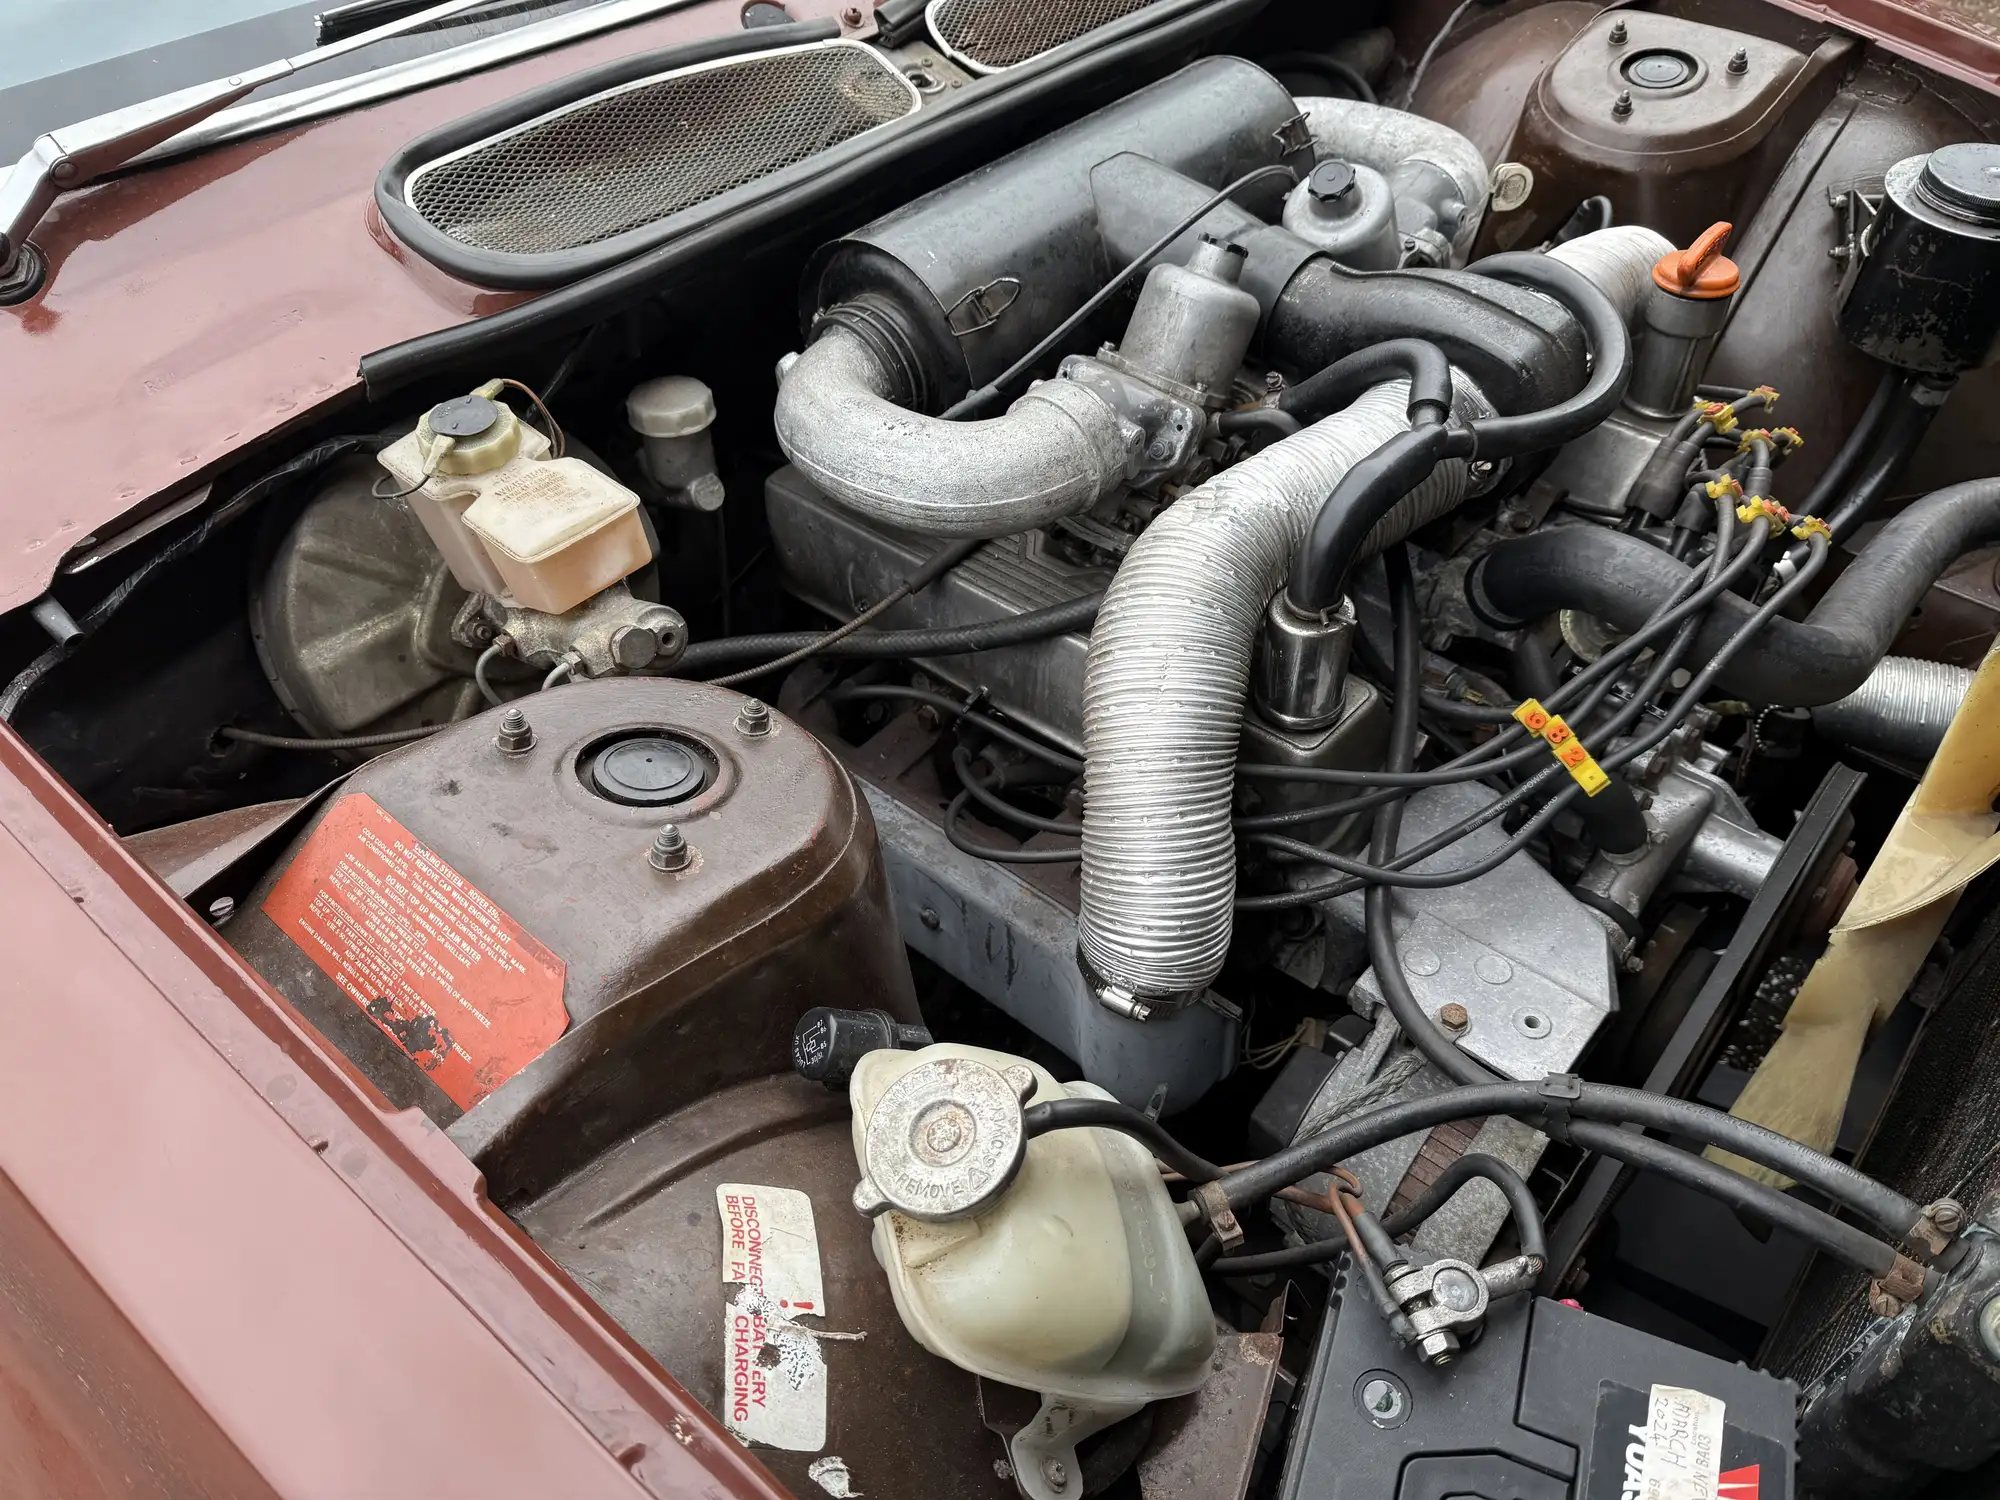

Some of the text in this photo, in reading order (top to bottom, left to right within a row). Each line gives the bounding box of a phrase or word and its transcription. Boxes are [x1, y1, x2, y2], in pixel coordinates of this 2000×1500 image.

[1548, 723, 1569, 744] 8
[1561, 746, 1585, 767] 2
[1521, 767, 1550, 793] POWER
[1539, 795, 1558, 814] LEAD
[347, 869, 376, 896] PROTECTION
[373, 893, 390, 909] DOWN
[354, 860, 382, 887] ANTI-FREEZE
[384, 888, 407, 909] BLUECOL
[411, 912, 438, 938] UNIVERSAL
[361, 827, 376, 841] COLD
[373, 838, 396, 859] COOLANT
[394, 856, 410, 871] LEVEL
[412, 871, 424, 883] FILL
[422, 880, 450, 906] EXPANSION
[447, 903, 462, 917] TANK
[364, 841, 395, 869] CONDITIONED
[393, 866, 408, 880] CARS
[410, 880, 424, 895] TURN
[422, 892, 457, 923] TEMPERATURE
[454, 920, 479, 943] CONTROL
[484, 946, 500, 961] FULL
[414, 858, 440, 882] REMOVE
[450, 890, 470, 909] WHEN
[467, 905, 491, 927] ENGINE
[439, 865, 464, 888] SYSTEM
[467, 889, 490, 910] ROVER
[308, 903, 325, 920] REFILL
[343, 938, 361, 955] LITRES
[378, 971, 394, 987] PINTS
[327, 898, 356, 926] PROTECTION
[352, 922, 369, 939] DOWN
[328, 874, 345, 890] REFILL
[364, 908, 382, 925] LITRES
[398, 939, 414, 956] PINTS
[426, 966, 439, 979] U.S.
[436, 975, 454, 993] PINTS)
[365, 898, 379, 912] PART
[383, 915, 413, 943] ANTI-FREEZE
[422, 950, 439, 967] PARTS
[374, 928, 391, 945] WATER
[395, 948, 408, 960] FILL
[427, 912, 444, 928] WITH
[442, 925, 462, 944] PLAIN
[459, 940, 482, 962] WATER
[298, 918, 316, 936] ENGINE
[313, 933, 333, 953] DAMAGE
[331, 950, 344, 964] WILL
[341, 960, 360, 979] RESULT
[362, 981, 378, 998] THESE
[344, 927, 358, 941] PART
[362, 944, 392, 974] ANTI-FREEZE
[400, 980, 415, 995] PART
[374, 978, 386, 991] FILL
[898, 1172, 966, 1199] REMOVE
[725, 1194, 749, 1422] BEFORE FA CHARGING
[750, 1315, 766, 1409] BATERY
[1649, 1396, 1669, 1446] 2024
[1661, 1399, 1692, 1469] MARCH
